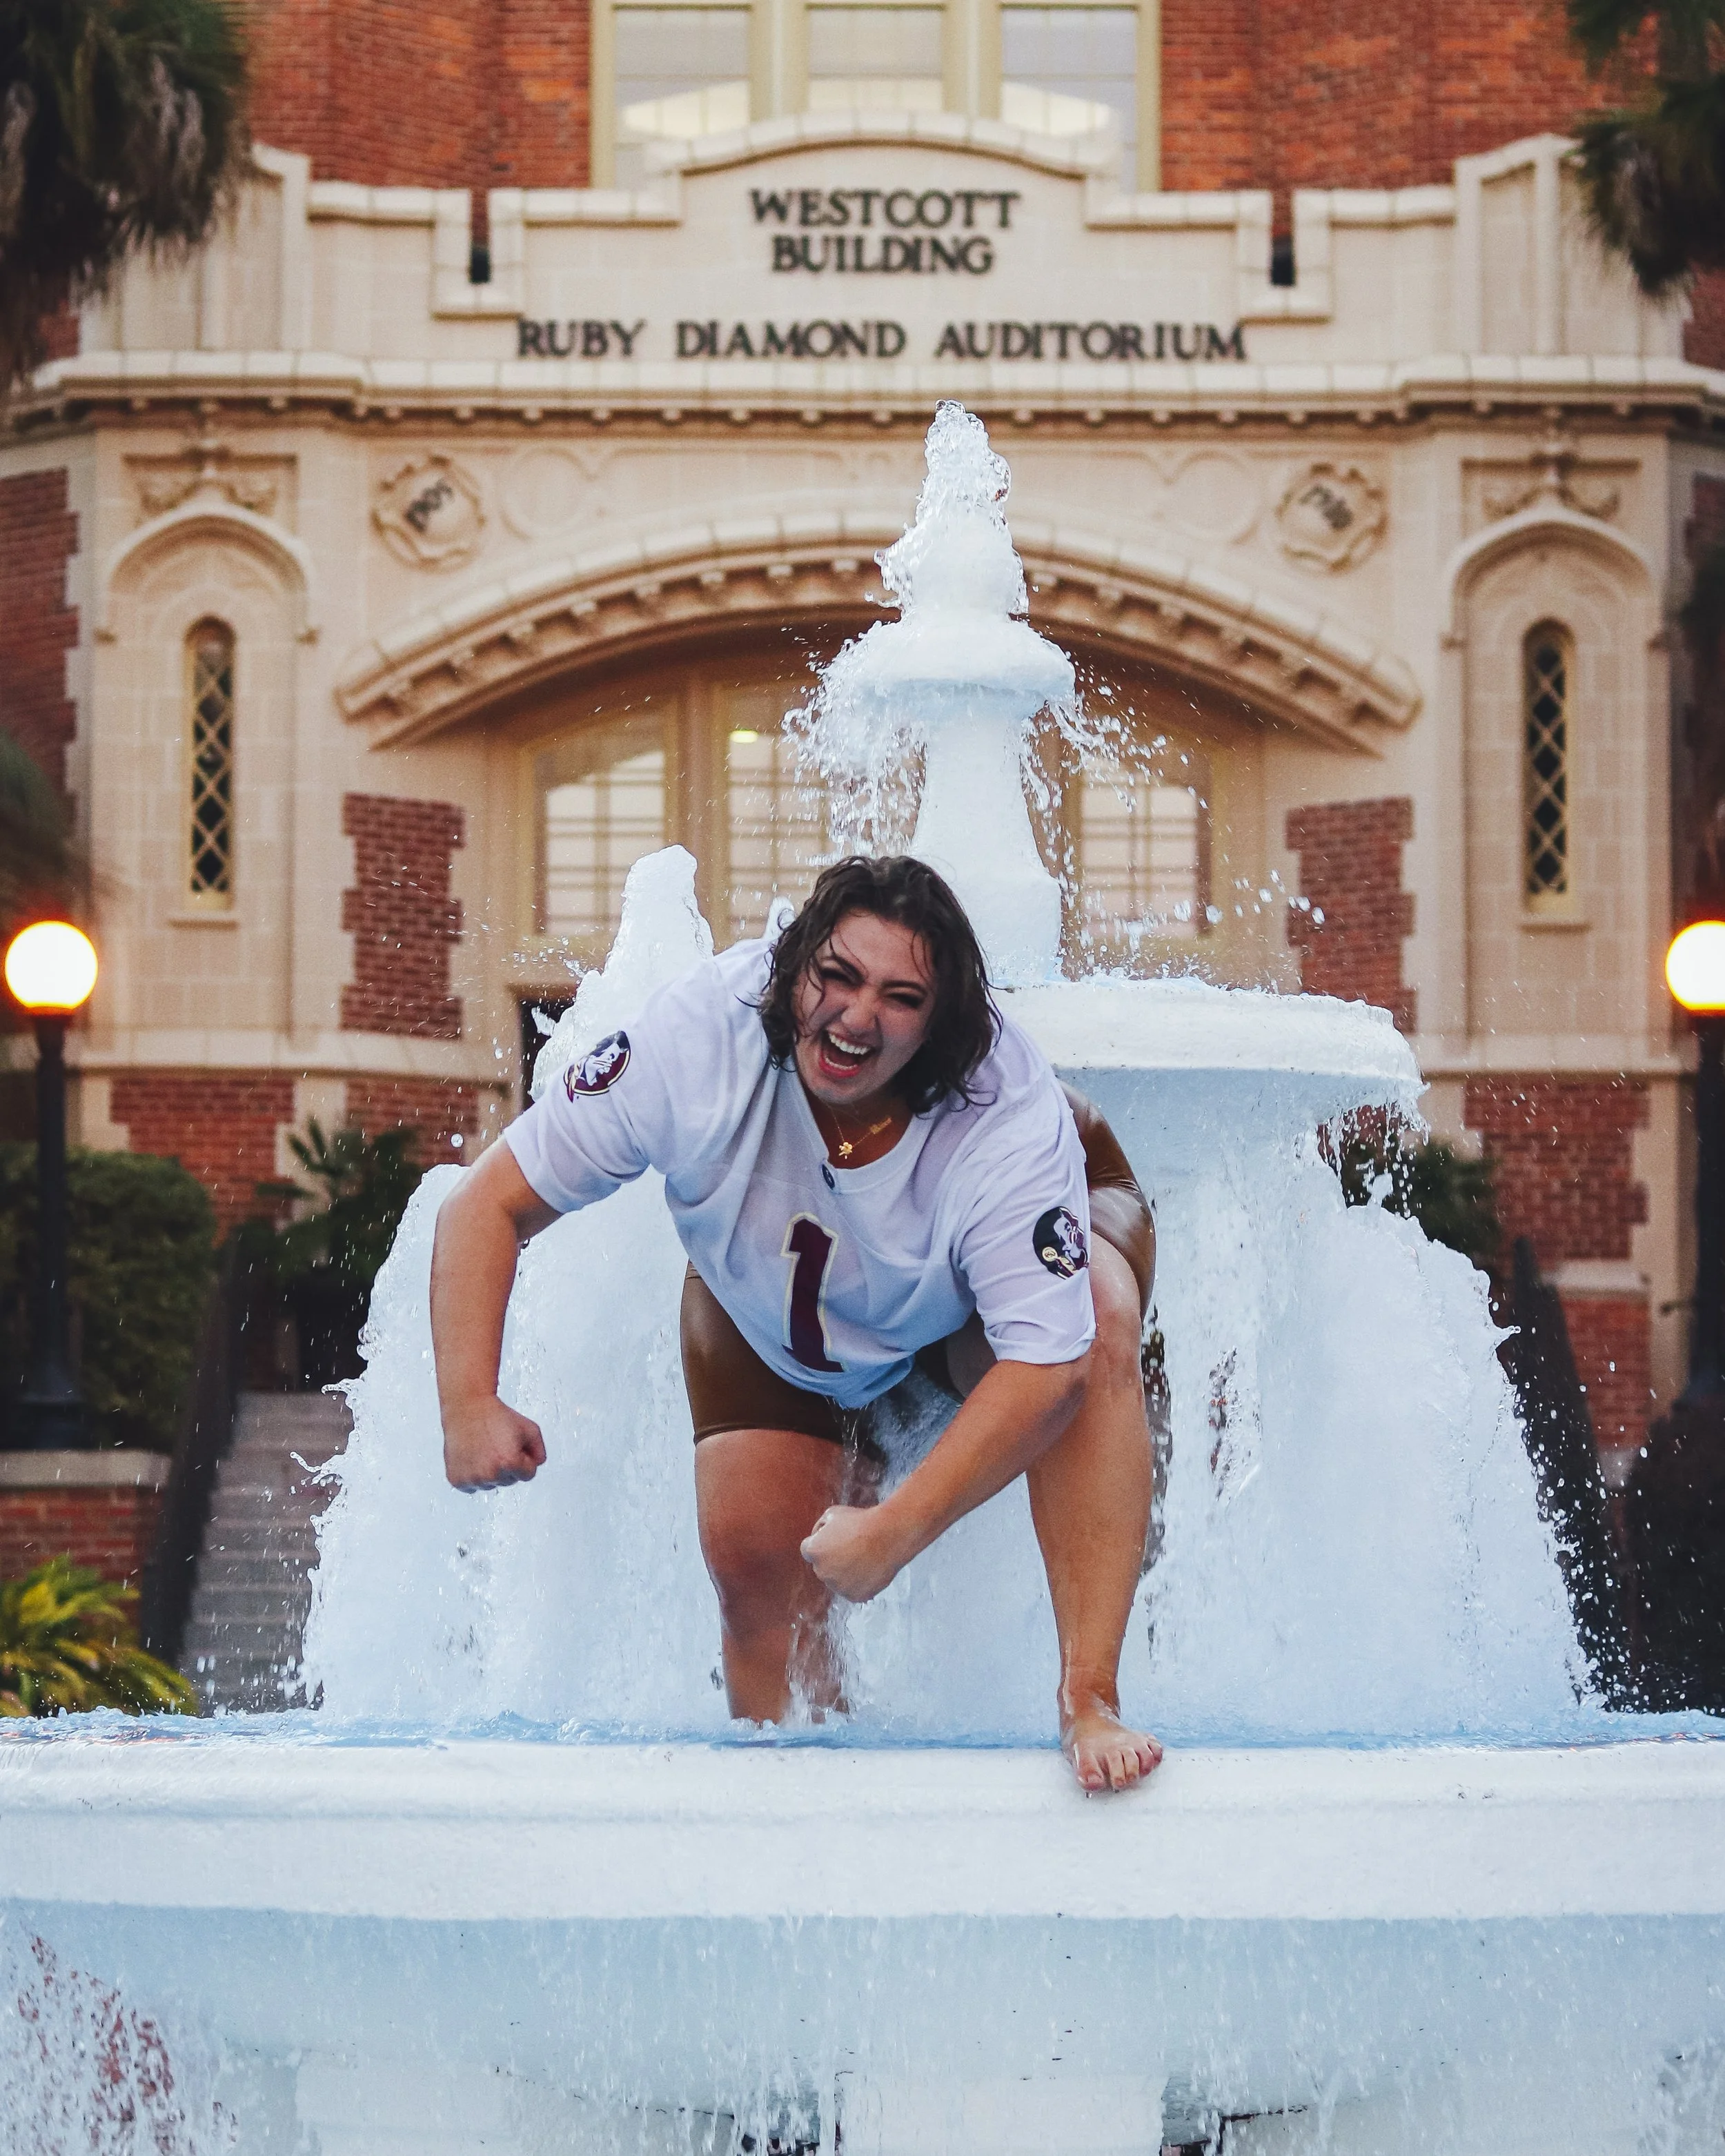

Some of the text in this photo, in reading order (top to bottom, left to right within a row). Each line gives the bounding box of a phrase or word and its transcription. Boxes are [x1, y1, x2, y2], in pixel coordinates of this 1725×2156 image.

[750, 189, 1021, 229] WESTCOTT
[771, 235, 994, 275] BUILDING
[518, 318, 1246, 362] RUBY DIAMOND AUDITORIUM
[781, 1213, 843, 1372] 1
